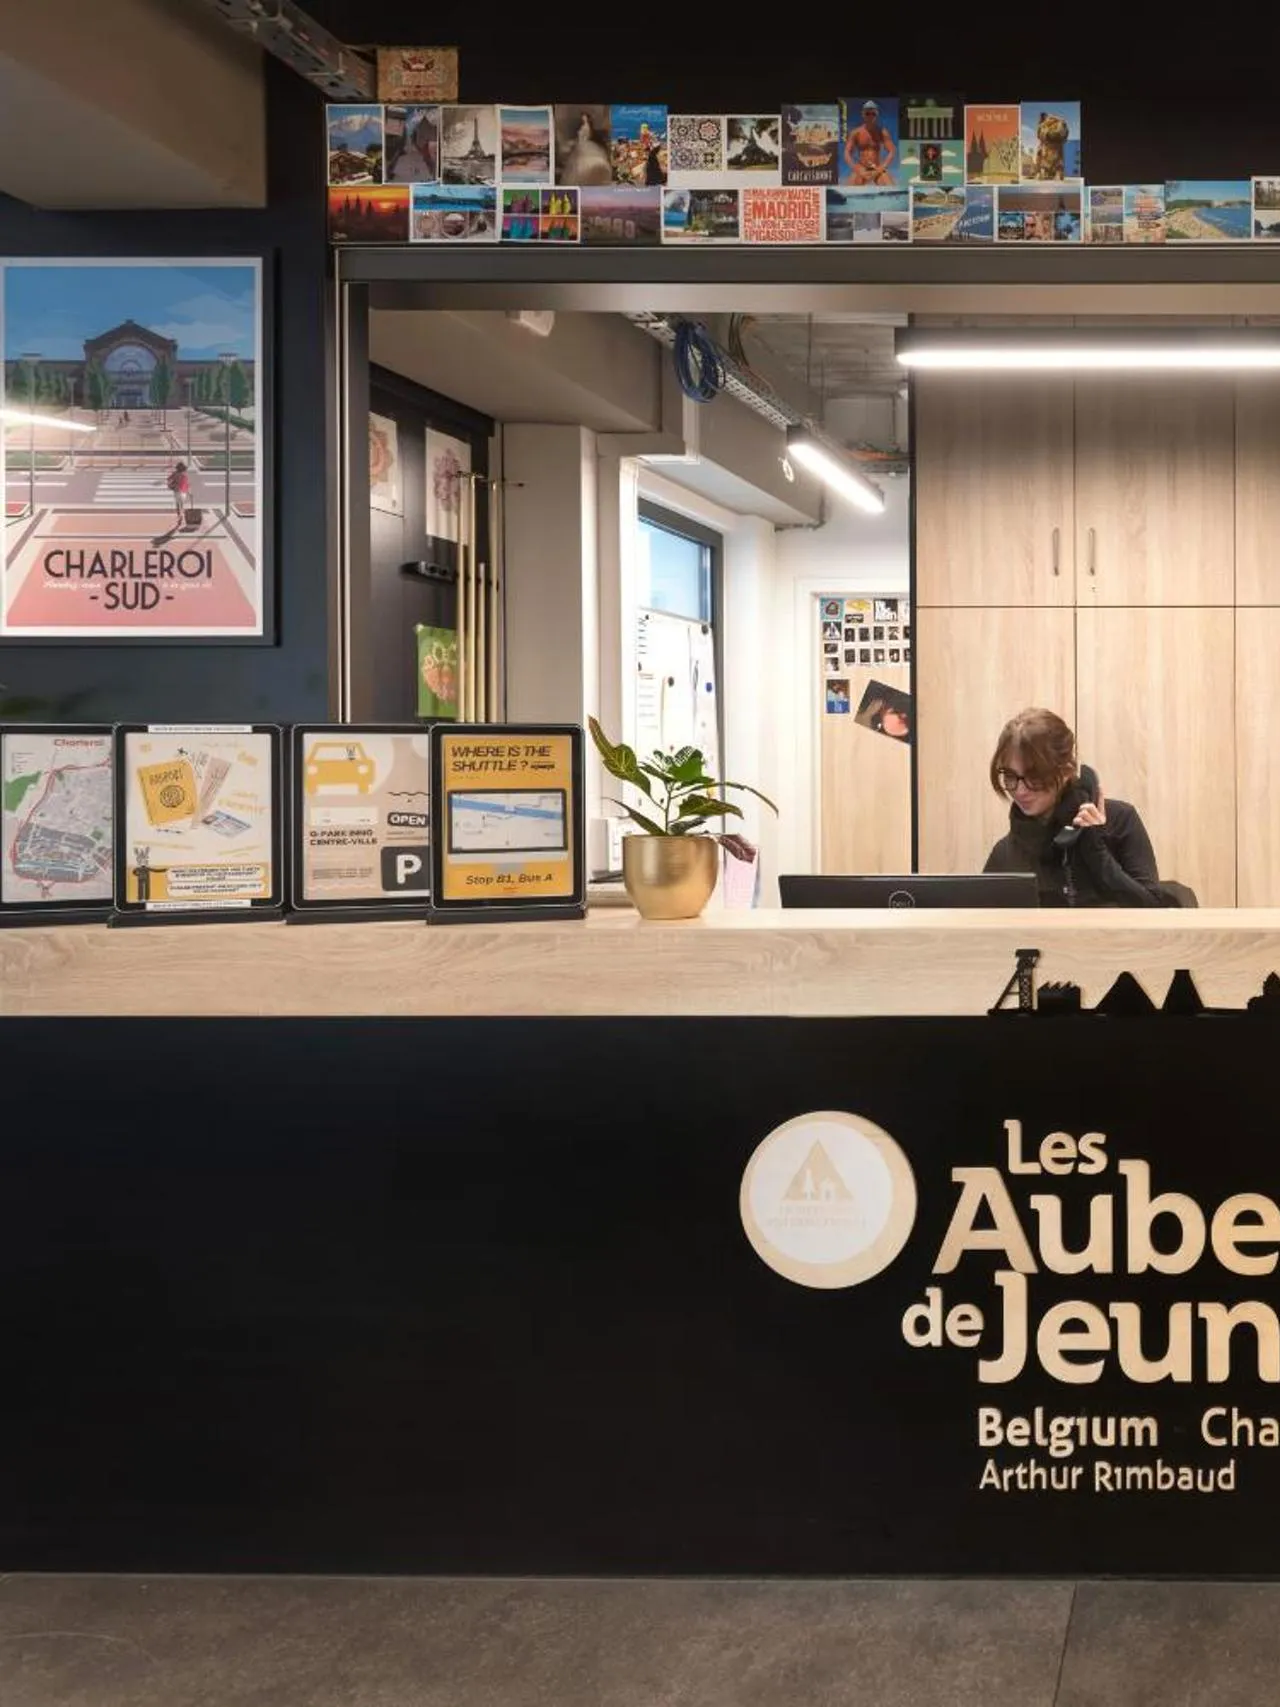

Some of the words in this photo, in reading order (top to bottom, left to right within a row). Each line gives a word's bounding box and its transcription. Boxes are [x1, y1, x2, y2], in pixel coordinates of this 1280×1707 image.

[752, 201, 811, 219] MADRID
[43, 549, 212, 578] CHARLEROI
[452, 745, 505, 757] WHERE
[508, 745, 521, 757] IS
[525, 745, 552, 757] THE
[451, 760, 517, 772] SHUTTLE
[389, 814, 426, 826] OPEN
[309, 838, 378, 846] CENTRE-VILLE
[396, 853, 422, 885] P
[466, 875, 494, 885] Stop
[1004, 1120, 1107, 1175] Les
[902, 1287, 983, 1348] de
[979, 1407, 1157, 1457] Belgium
[979, 1459, 1083, 1491] Arthur
[1095, 1459, 1235, 1492] Rimbaud
